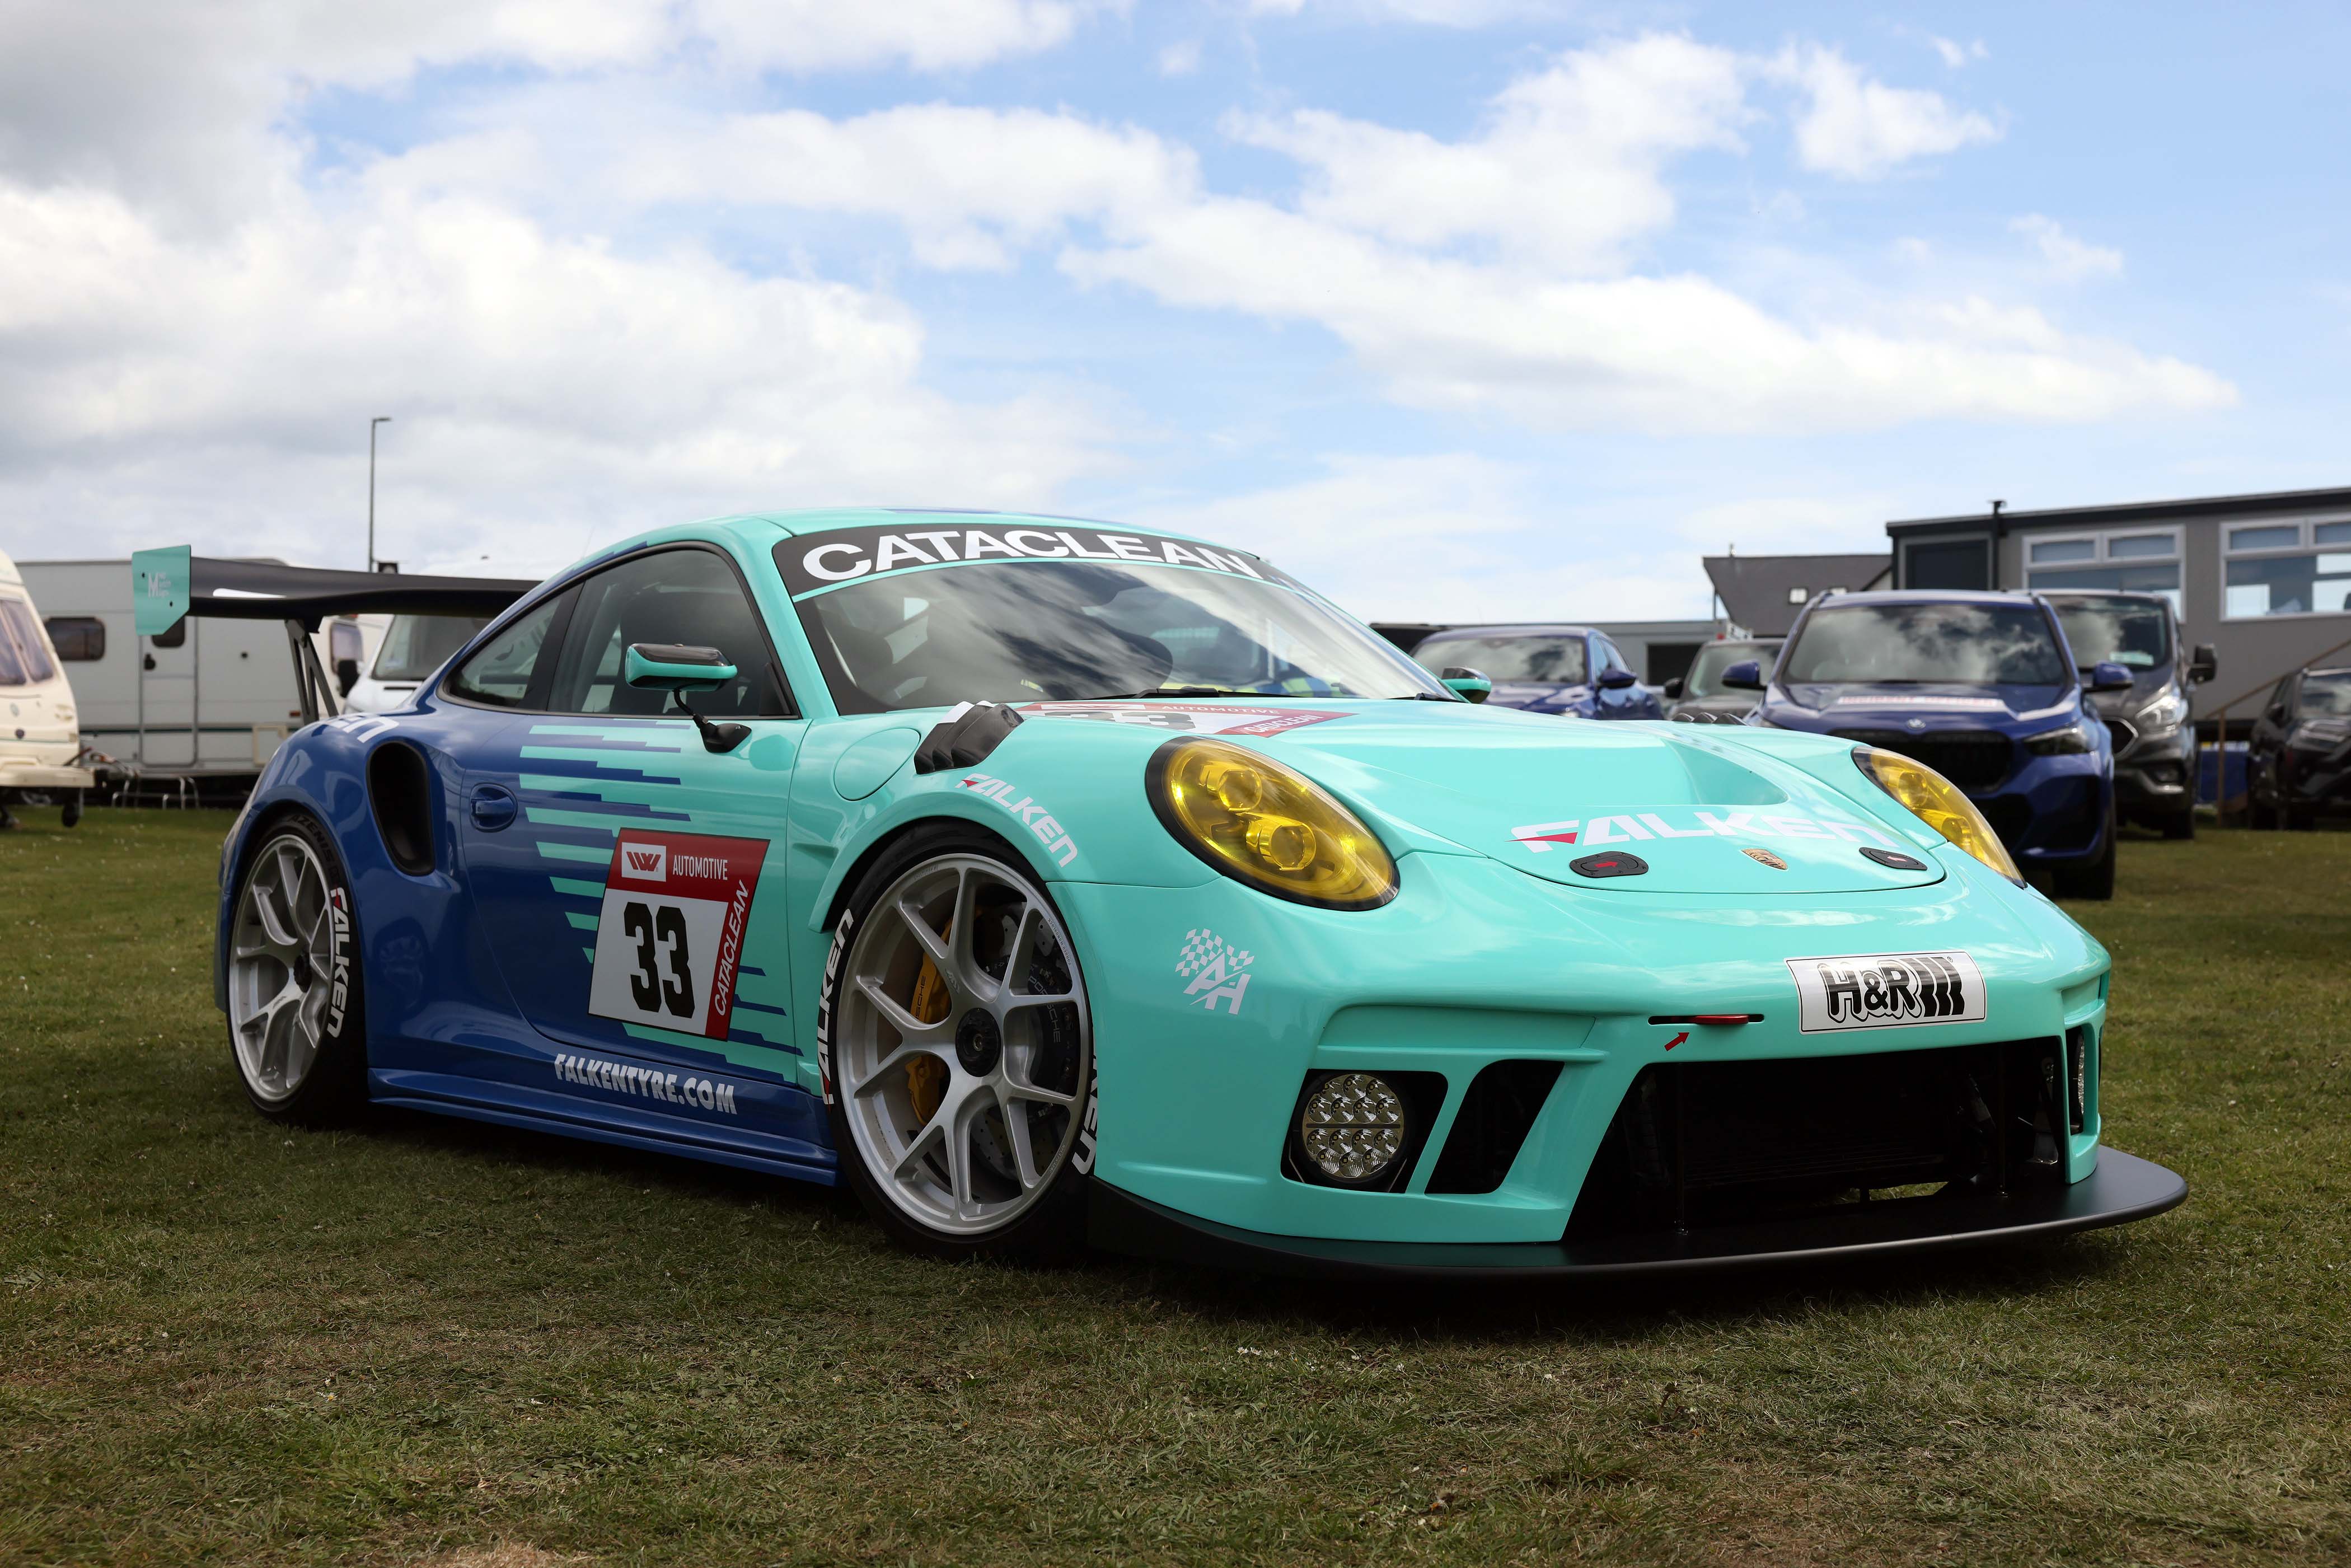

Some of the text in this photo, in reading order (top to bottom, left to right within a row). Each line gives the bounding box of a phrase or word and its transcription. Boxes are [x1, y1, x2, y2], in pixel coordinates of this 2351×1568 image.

[803, 530, 1264, 580] CATACLEAN
[1162, 705, 1280, 714] AUTOMOTIVE
[1243, 714, 1324, 733] CATACLEAN
[954, 773, 1078, 868] FALKEN
[1508, 812, 1901, 853] FALKEN
[672, 855, 728, 881] AUTOMOTIVE
[327, 887, 350, 1038] FALKEN
[624, 901, 695, 1019] 33
[715, 879, 749, 1016] CATACLEAN
[817, 909, 854, 1106] FALKEN
[554, 1054, 737, 1115] FALKENTYRE.COM
